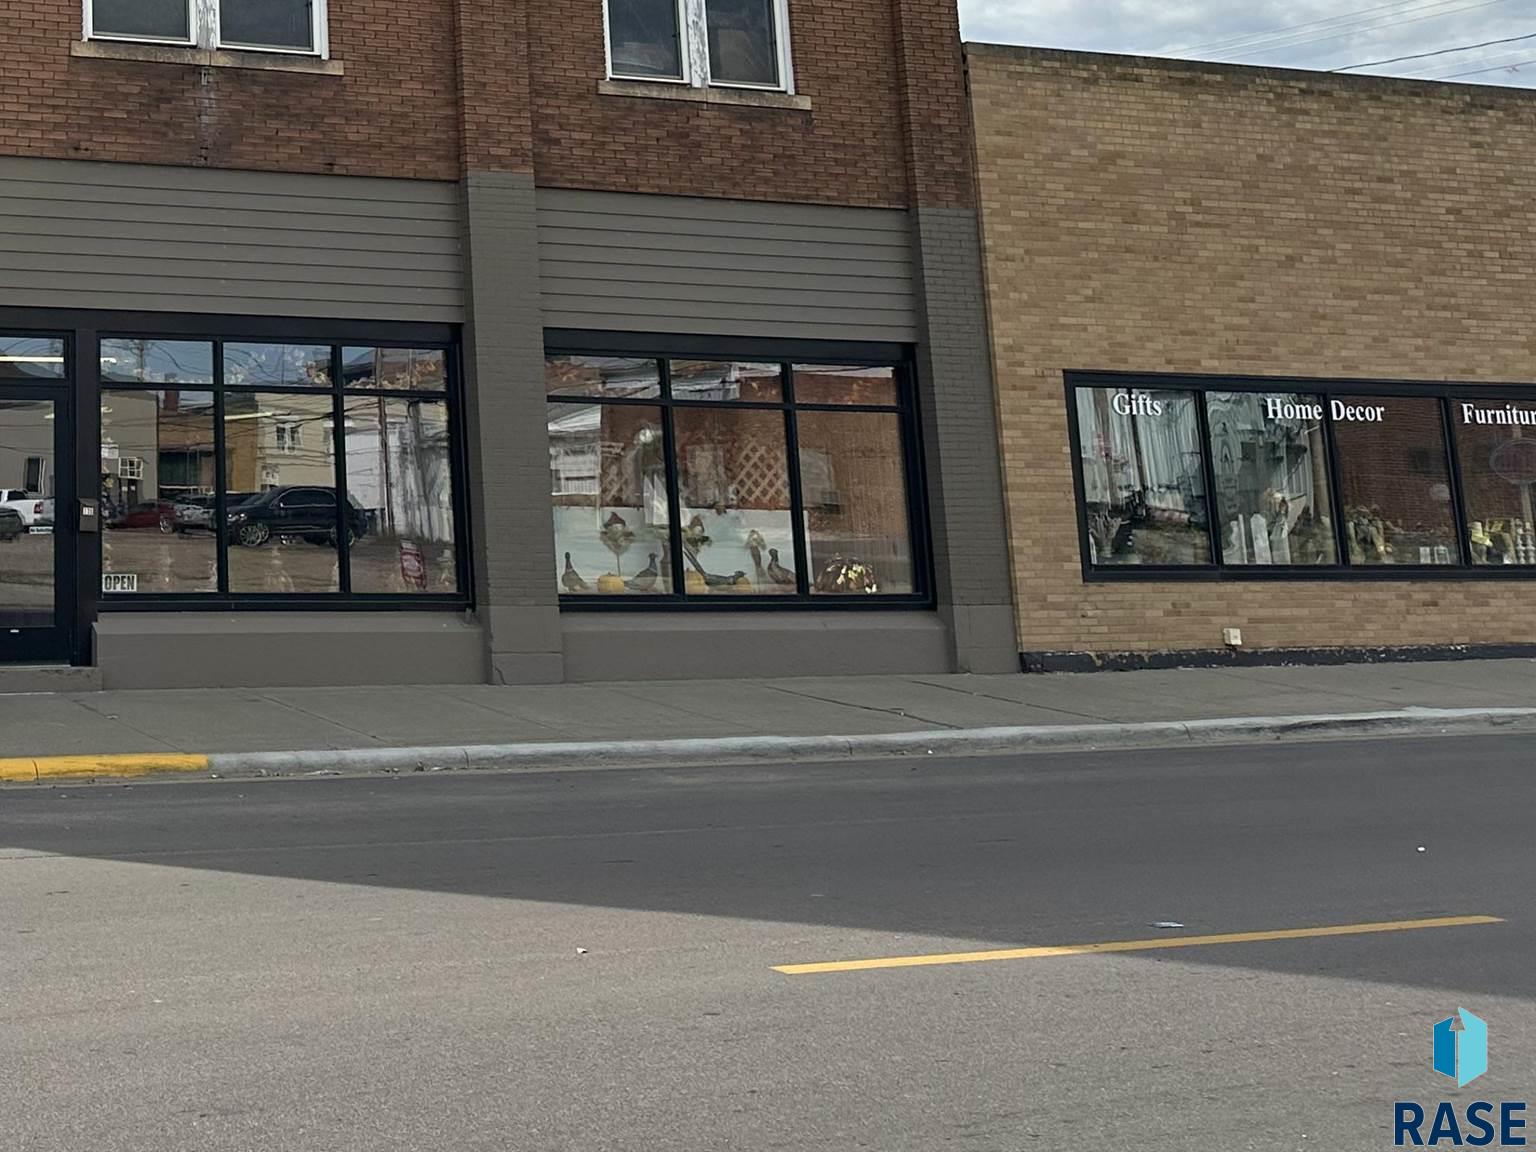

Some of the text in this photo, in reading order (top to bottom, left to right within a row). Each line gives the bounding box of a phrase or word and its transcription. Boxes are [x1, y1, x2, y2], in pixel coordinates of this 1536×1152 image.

[1113, 393, 1162, 416] Gifts
[1267, 398, 1385, 422] Home Decor
[104, 575, 135, 591] OPEN
